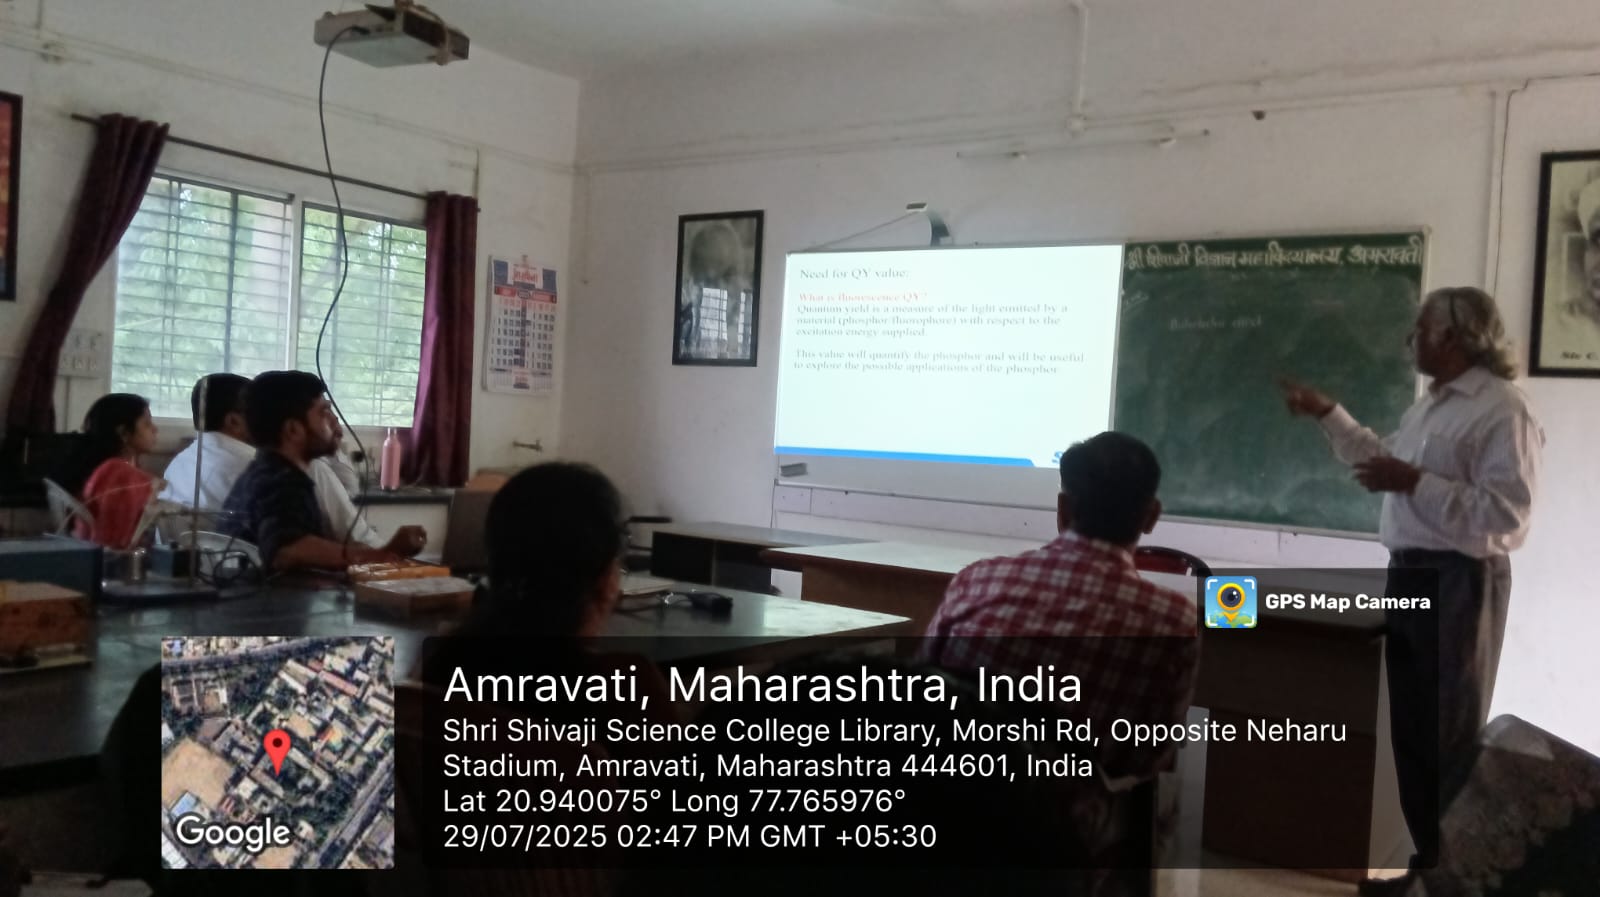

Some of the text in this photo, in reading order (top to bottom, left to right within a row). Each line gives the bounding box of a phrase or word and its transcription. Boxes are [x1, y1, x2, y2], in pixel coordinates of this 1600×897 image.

[1126, 246, 1145, 270] श्री
[1146, 242, 1190, 268] शिवाजी
[1347, 235, 1421, 265] अमरावती
[800, 268, 829, 279] Need
[833, 268, 848, 279] for
[851, 268, 872, 280] QY
[799, 292, 824, 302] What
[838, 292, 900, 302] fluorescence
[797, 304, 843, 314] Quantum
[845, 303, 870, 315] yield
[872, 304, 881, 313] is
[892, 305, 935, 313] measure
[937, 303, 951, 313] of
[952, 302, 968, 313] the
[971, 302, 995, 315] light
[999, 302, 1041, 313] emitted
[1044, 302, 1057, 315] by
[796, 316, 836, 325] material
[959, 315, 984, 325] with
[987, 316, 1025, 328] respect
[1029, 316, 1041, 325] to
[1043, 315, 1062, 325] the
[796, 328, 844, 336] excitation
[845, 330, 878, 339] energy
[795, 349, 1086, 363] This value will quantify the phosphor and will be useful
[793, 361, 805, 370] to
[806, 361, 842, 372] explore
[844, 361, 860, 370] the
[862, 362, 904, 373] possible
[905, 363, 969, 375] applications
[971, 363, 984, 373] of
[986, 363, 1003, 374] the
